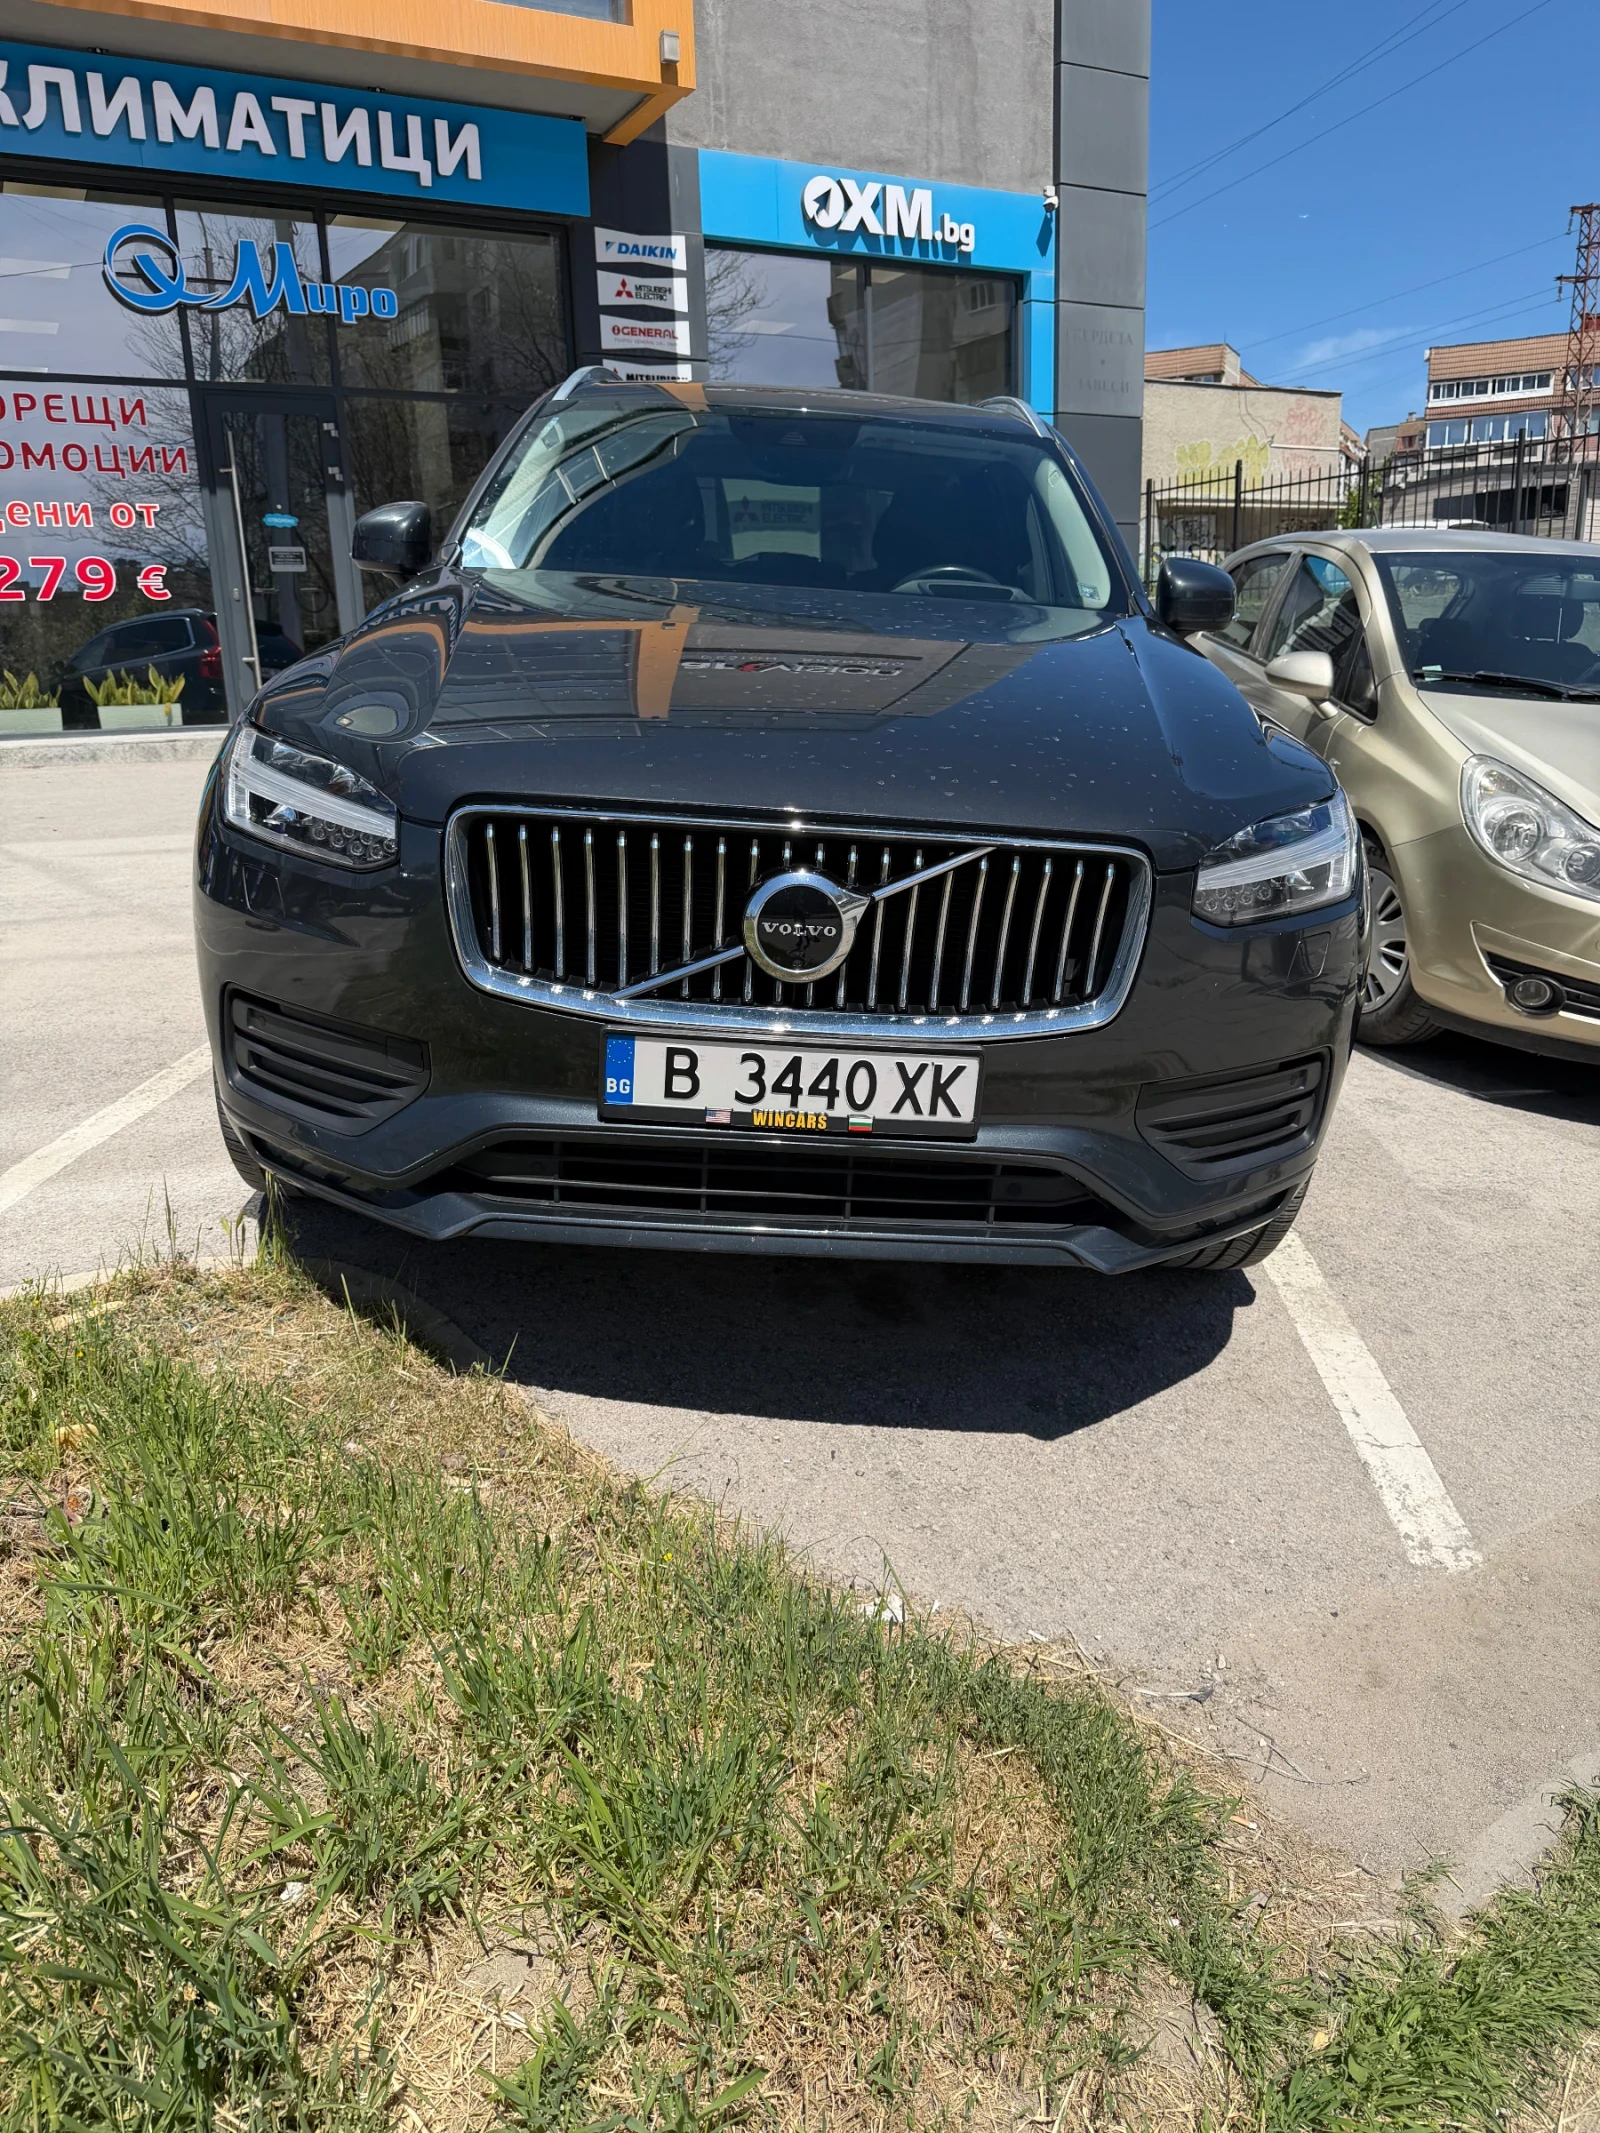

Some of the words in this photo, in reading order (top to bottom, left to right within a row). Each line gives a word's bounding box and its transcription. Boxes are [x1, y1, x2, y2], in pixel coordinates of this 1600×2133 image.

[617, 242, 677, 260] DAIKIN
[634, 284, 672, 295] MITSUBISHI
[635, 292, 668, 302] ELECTRIC
[0, 393, 148, 431] РЕЩИ
[0, 500, 94, 533] ени
[110, 503, 160, 528] от
[137, 565, 172, 600] €
[761, 921, 837, 937] VOLVO
[606, 1078, 631, 1093] BG
[664, 1047, 700, 1100] B
[734, 1052, 878, 1112] 3440
[890, 1061, 968, 1118] XK
[752, 1110, 828, 1130] WINCARS
